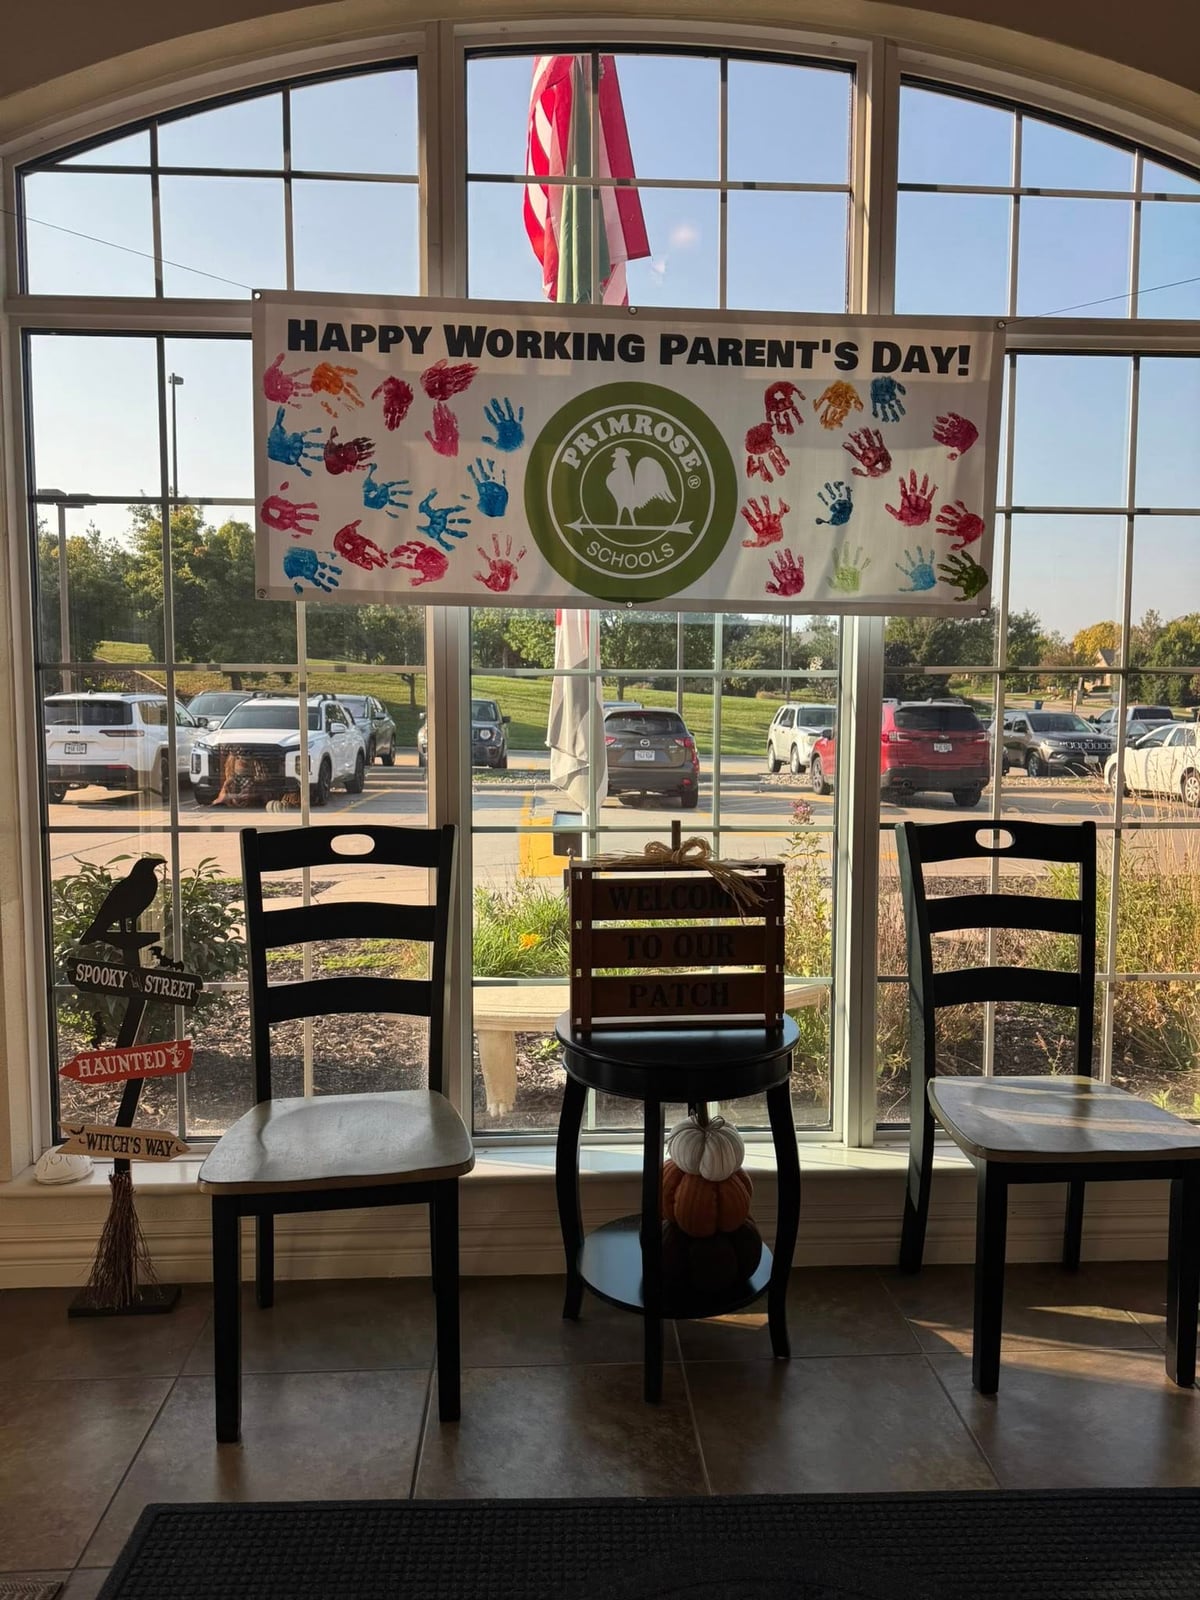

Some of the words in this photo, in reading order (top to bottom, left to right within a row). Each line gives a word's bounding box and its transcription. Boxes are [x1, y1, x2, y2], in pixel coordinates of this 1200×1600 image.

[287, 319, 432, 355] HAPPY
[443, 324, 645, 363] WORKING
[660, 333, 859, 372] PARENT'S
[871, 341, 971, 376] DAY!
[561, 413, 702, 473] PRIMROSE
[586, 541, 675, 569] SCHOOLS
[608, 884, 746, 912] WELCOM
[622, 934, 663, 961] TO
[673, 932, 736, 958] OUR
[75, 964, 127, 989] SPOOKY
[144, 974, 195, 1000] STREET
[628, 982, 729, 1009] PATCH
[77, 1050, 166, 1077] HAUNTED
[86, 1132, 141, 1155] WITCH'S
[145, 1136, 175, 1157] WAY
